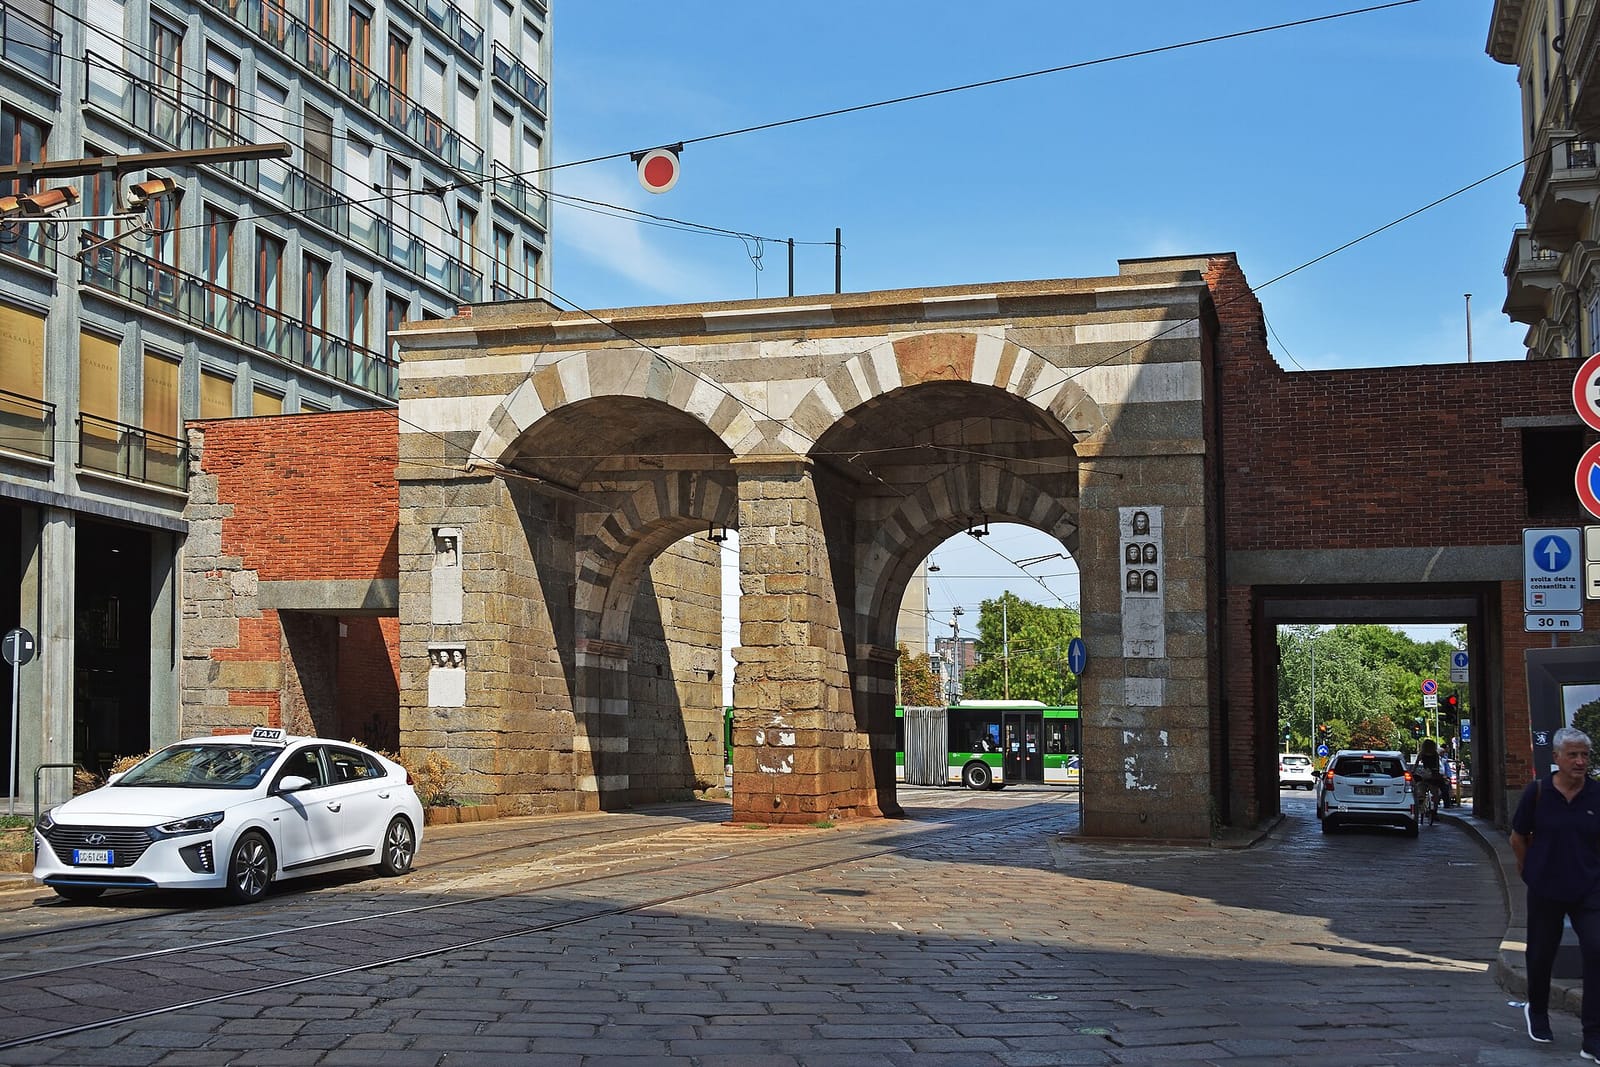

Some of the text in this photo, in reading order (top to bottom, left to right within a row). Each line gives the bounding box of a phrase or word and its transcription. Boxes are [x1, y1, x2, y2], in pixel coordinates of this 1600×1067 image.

[1538, 617, 1570, 627] 30 m
[1463, 725, 1469, 733] P
[255, 730, 280, 739] TAXI
